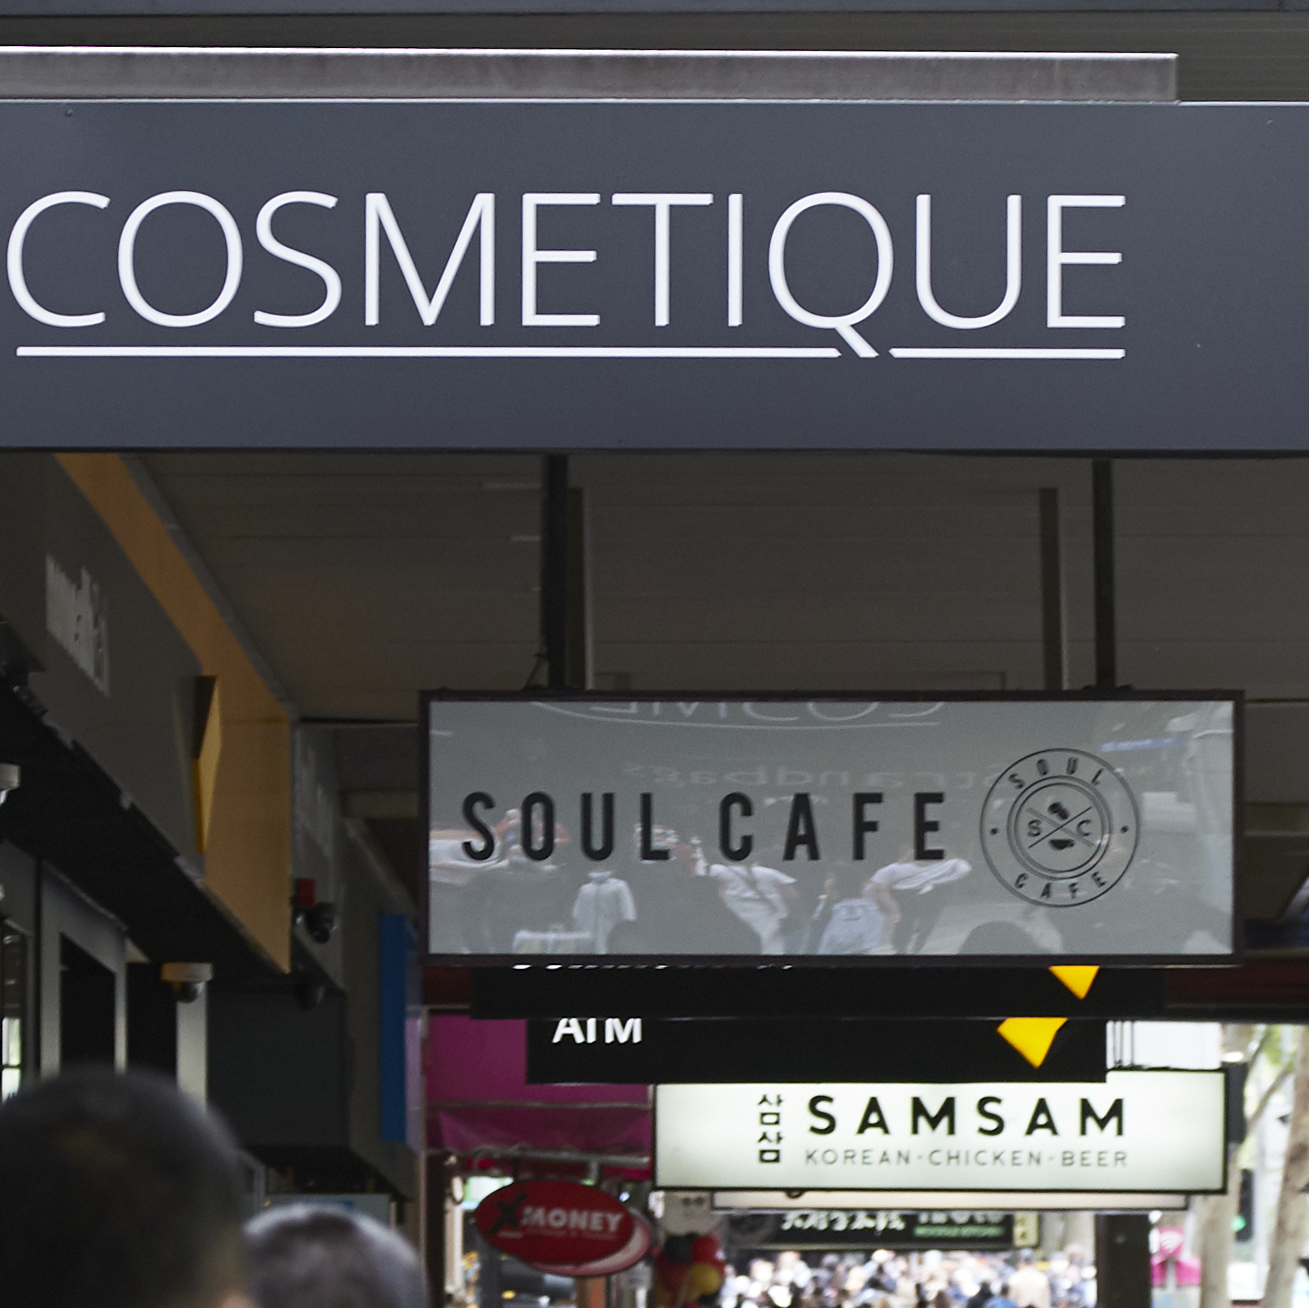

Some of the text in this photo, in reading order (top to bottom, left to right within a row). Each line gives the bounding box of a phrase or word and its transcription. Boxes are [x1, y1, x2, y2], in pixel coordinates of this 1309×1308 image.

[6, 189, 1127, 358] COSMETIQUE
[1008, 756, 1106, 790] SOUL
[462, 791, 946, 862] SOUL CAFE
[1014, 870, 1107, 899] CAFE
[808, 1095, 1125, 1136] SAMSAM
